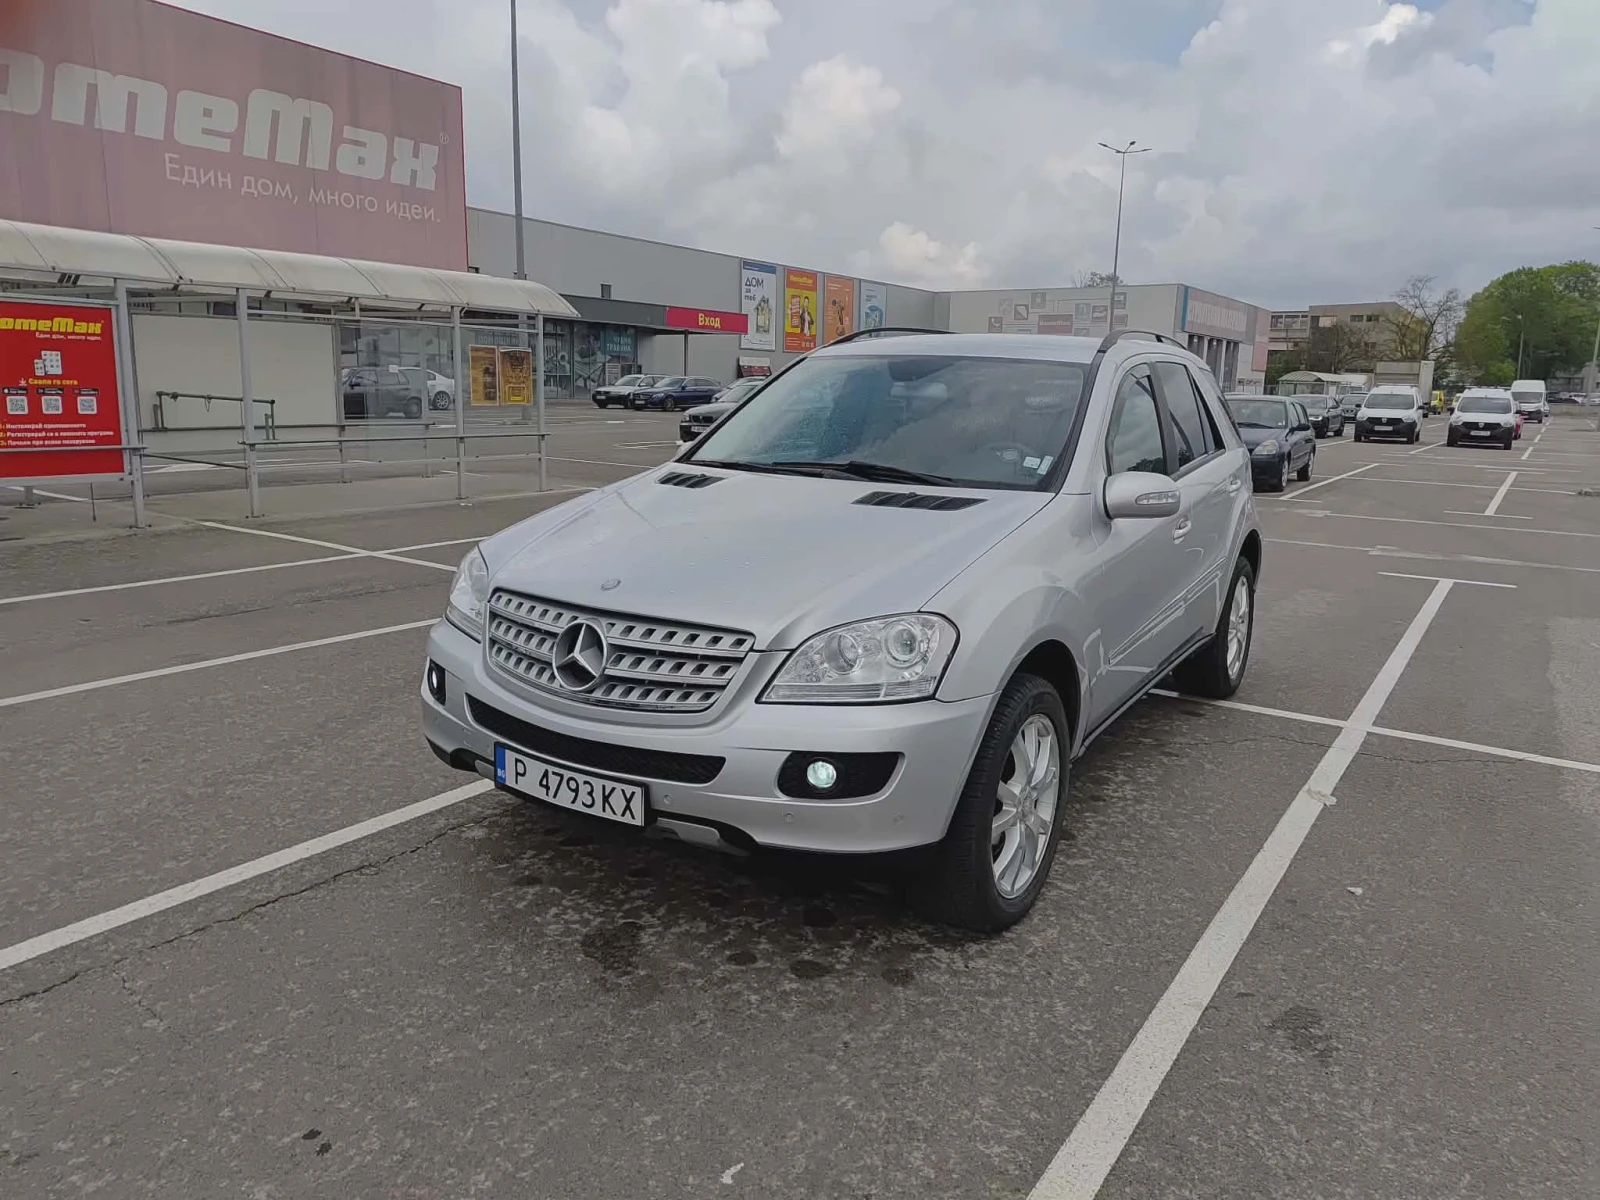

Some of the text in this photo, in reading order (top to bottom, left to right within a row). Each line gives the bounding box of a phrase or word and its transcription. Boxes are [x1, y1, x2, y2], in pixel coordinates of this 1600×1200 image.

[165, 153, 441, 222] Един дом, много идеи.
[745, 277, 764, 288] ДОМ
[698, 313, 721, 328] Вход
[497, 768, 505, 778] BG
[514, 757, 636, 820] P 4793 KX
